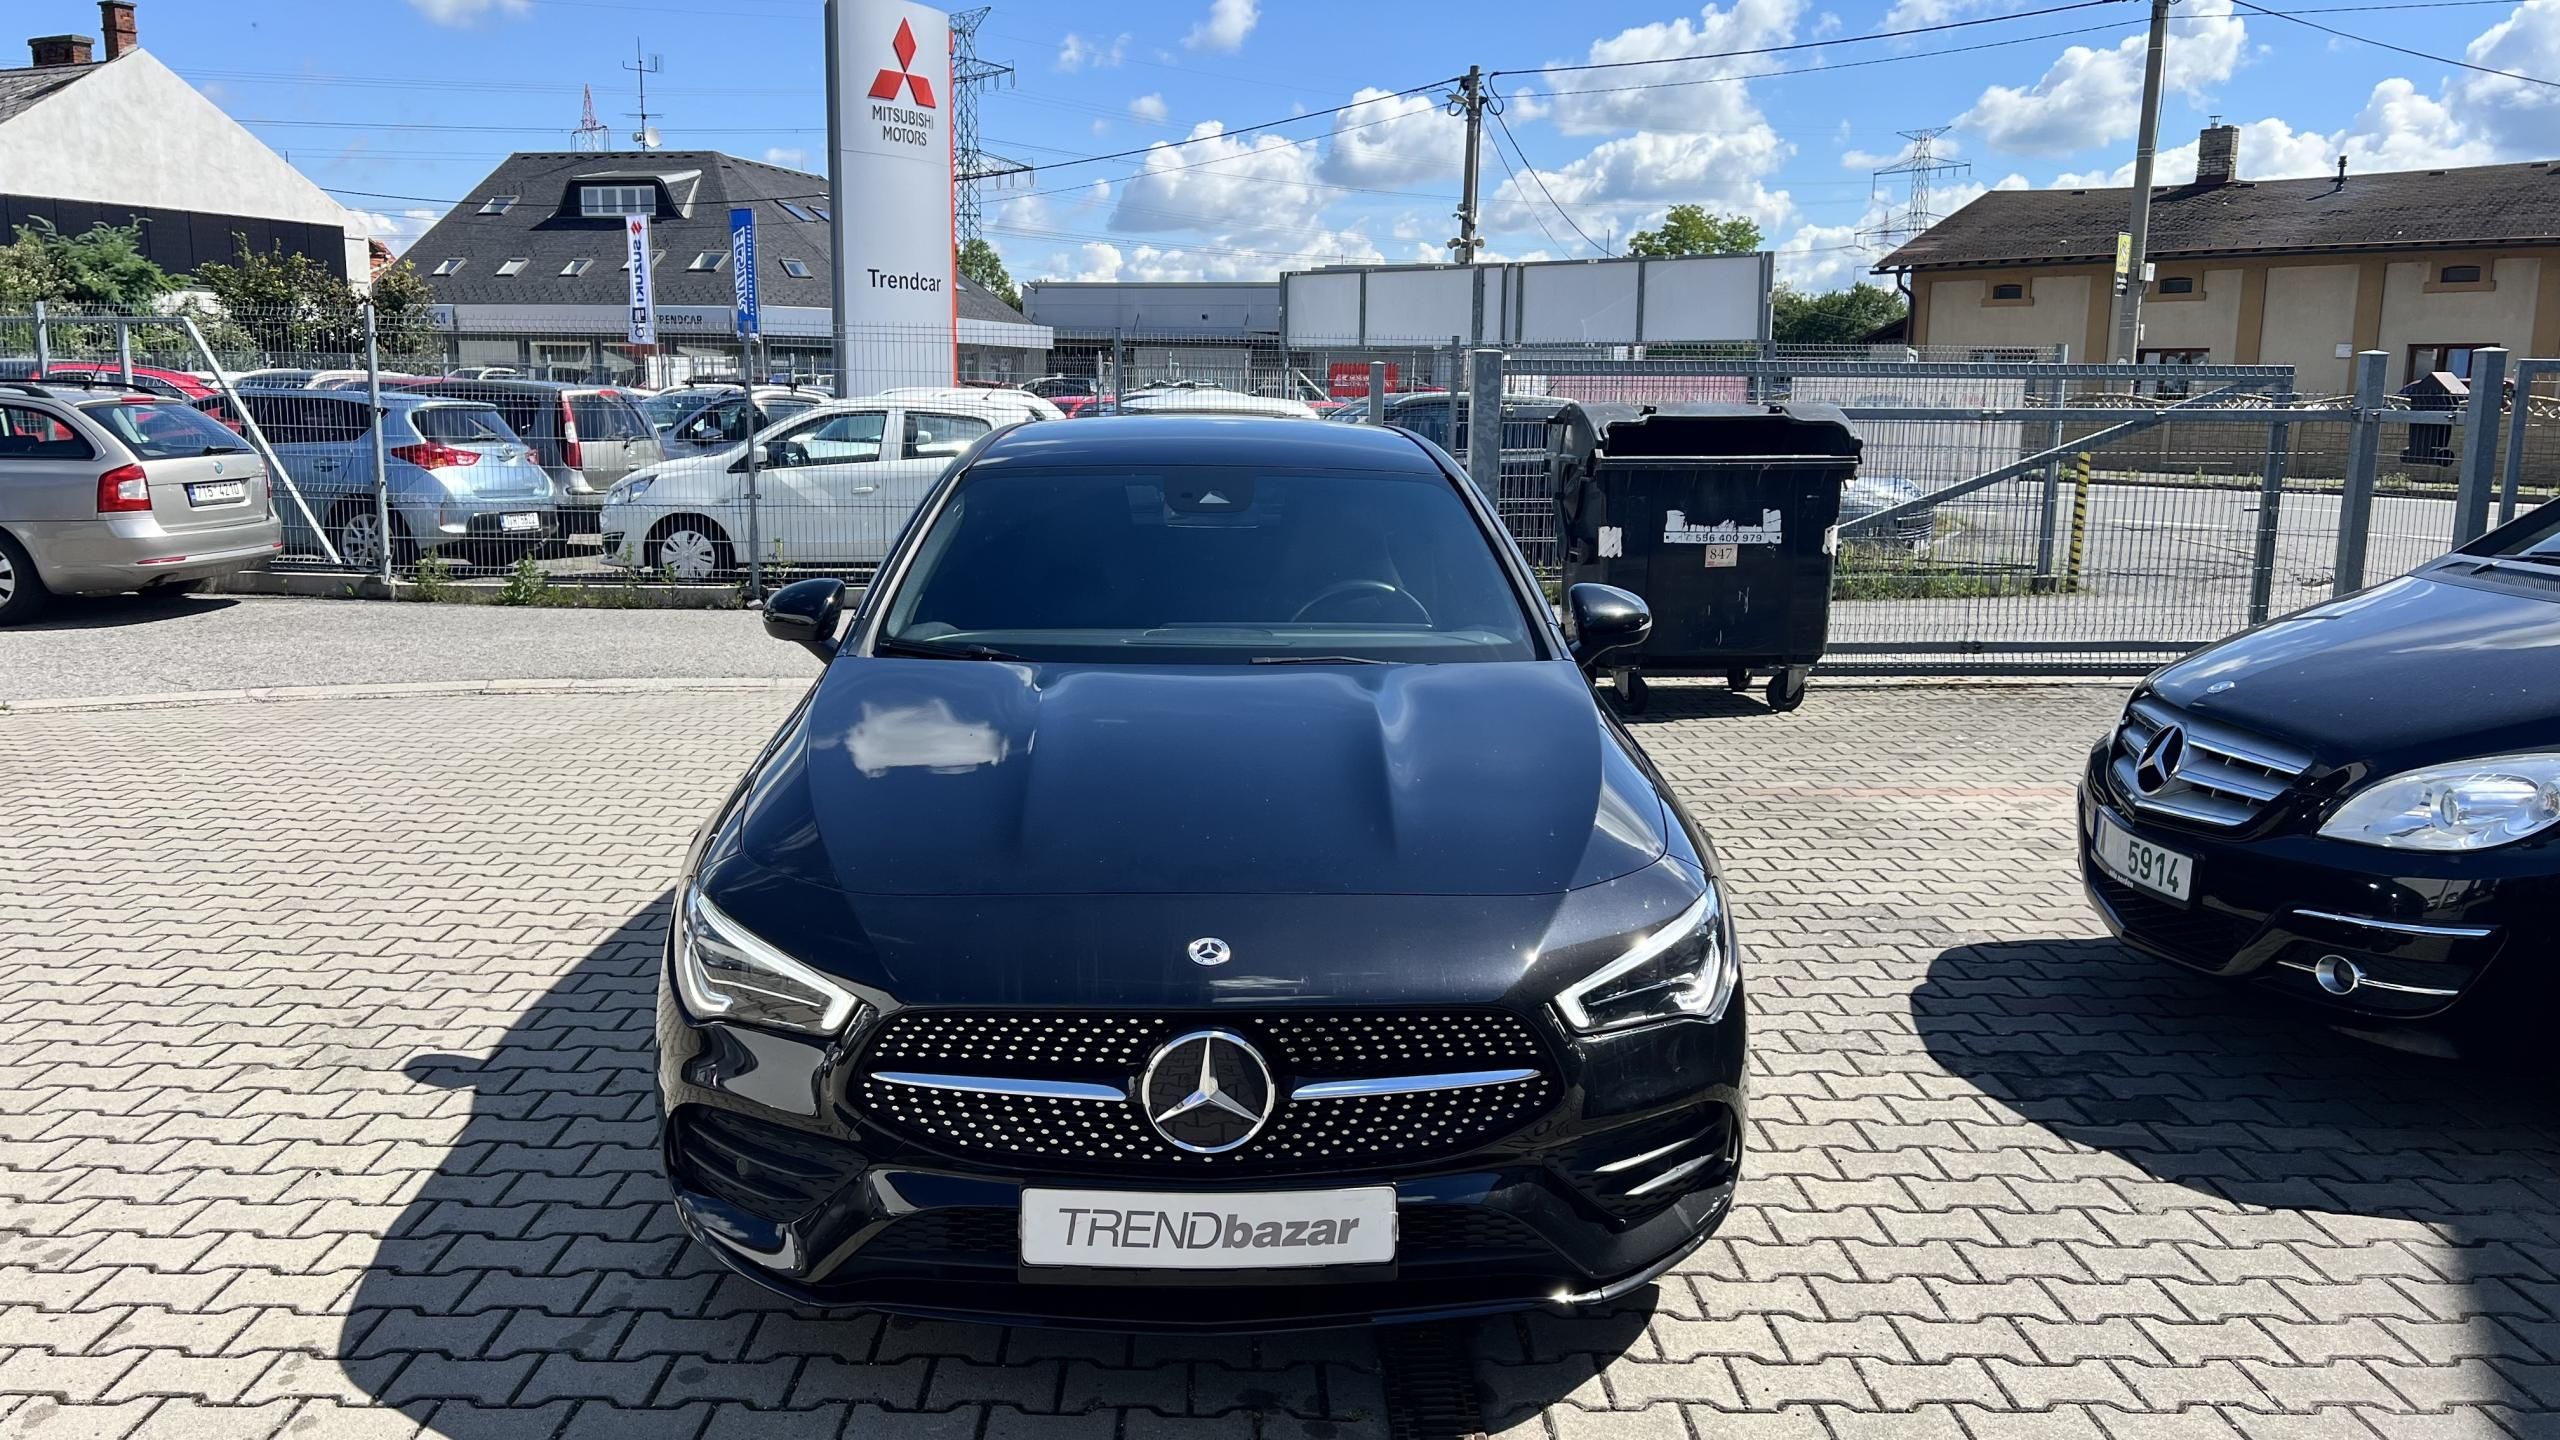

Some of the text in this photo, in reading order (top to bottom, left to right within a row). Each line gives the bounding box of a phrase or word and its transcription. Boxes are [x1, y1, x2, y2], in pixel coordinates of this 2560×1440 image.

[872, 105, 934, 128] MITSUBISHI
[883, 126, 927, 146] MOTORS
[867, 268, 942, 292] Trendcar
[656, 314, 703, 325] RENDCAR
[1718, 534, 1739, 543] 400
[1742, 534, 1763, 543] 979
[1709, 547, 1734, 560] 847
[2127, 839, 2180, 894] 5914
[1058, 1207, 1360, 1250] TRENDbazar
